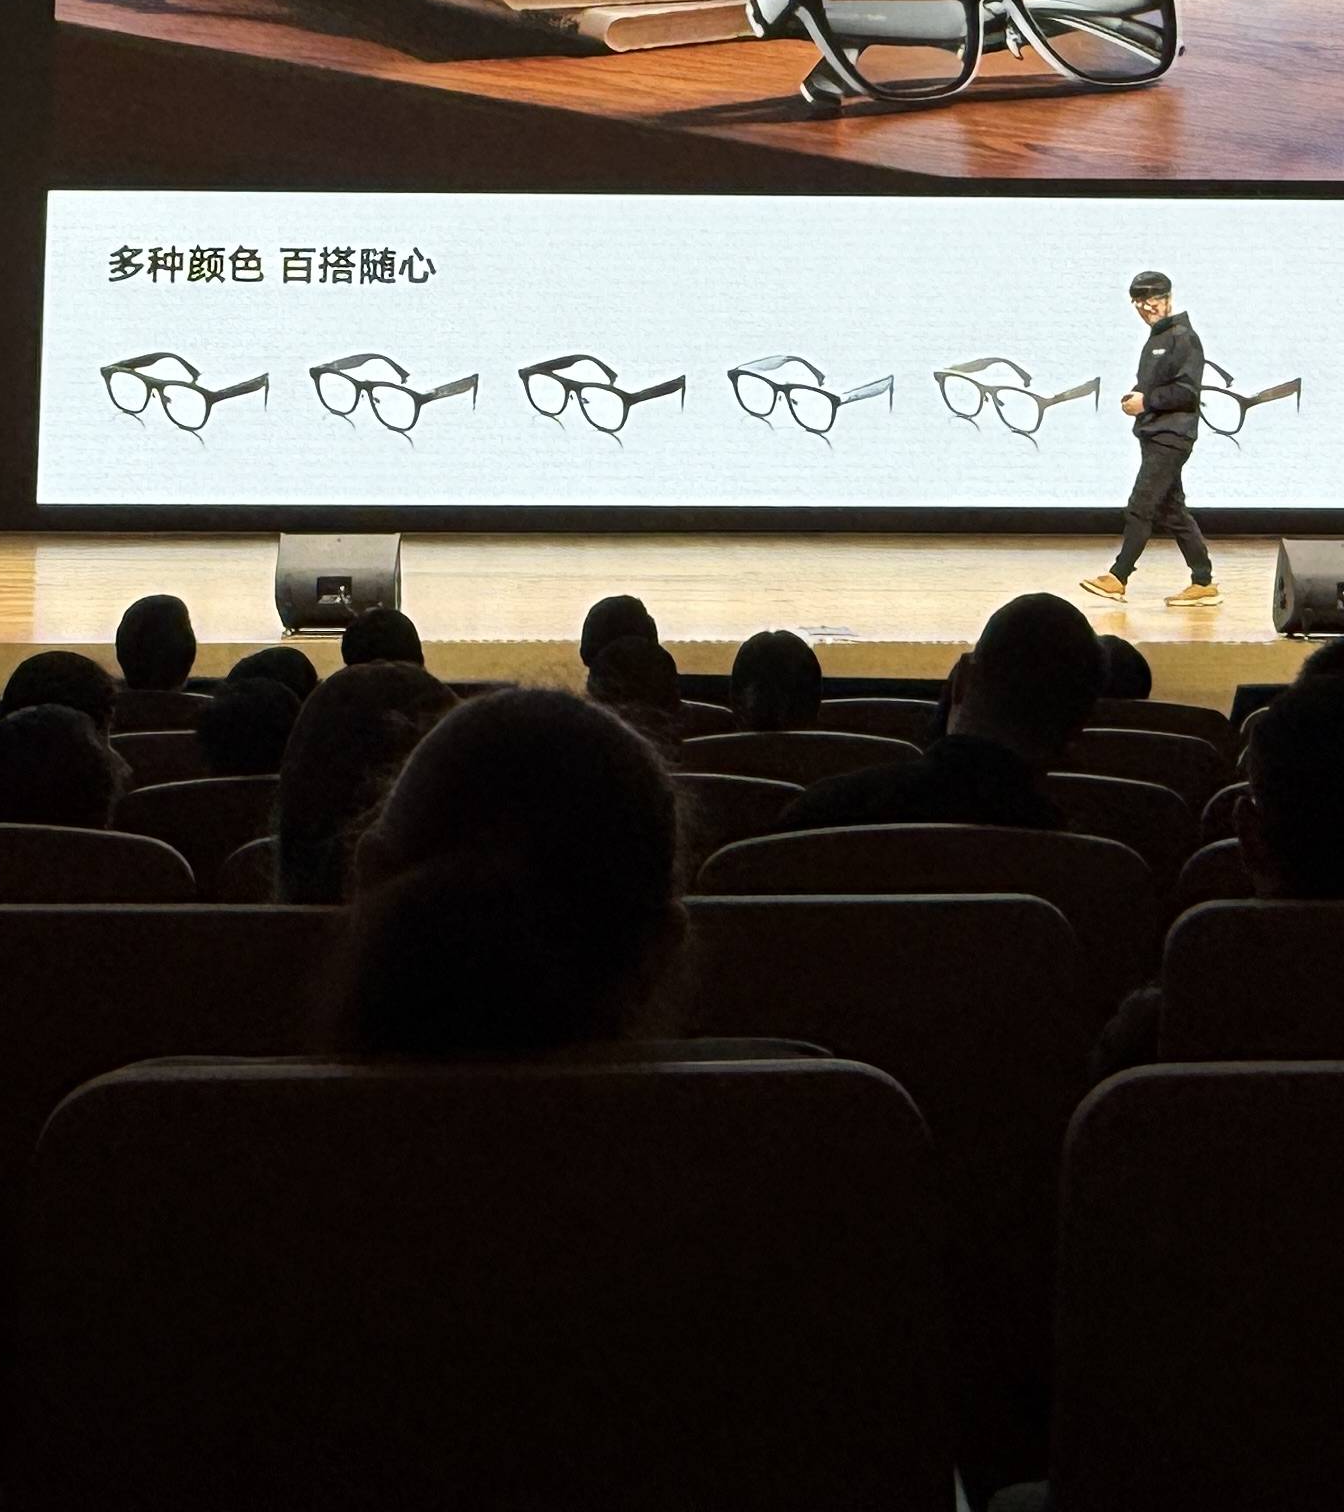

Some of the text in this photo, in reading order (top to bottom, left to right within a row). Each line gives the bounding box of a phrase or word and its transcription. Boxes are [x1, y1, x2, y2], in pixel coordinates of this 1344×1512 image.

[109, 245, 436, 284] 多种颜色 百搭随心
